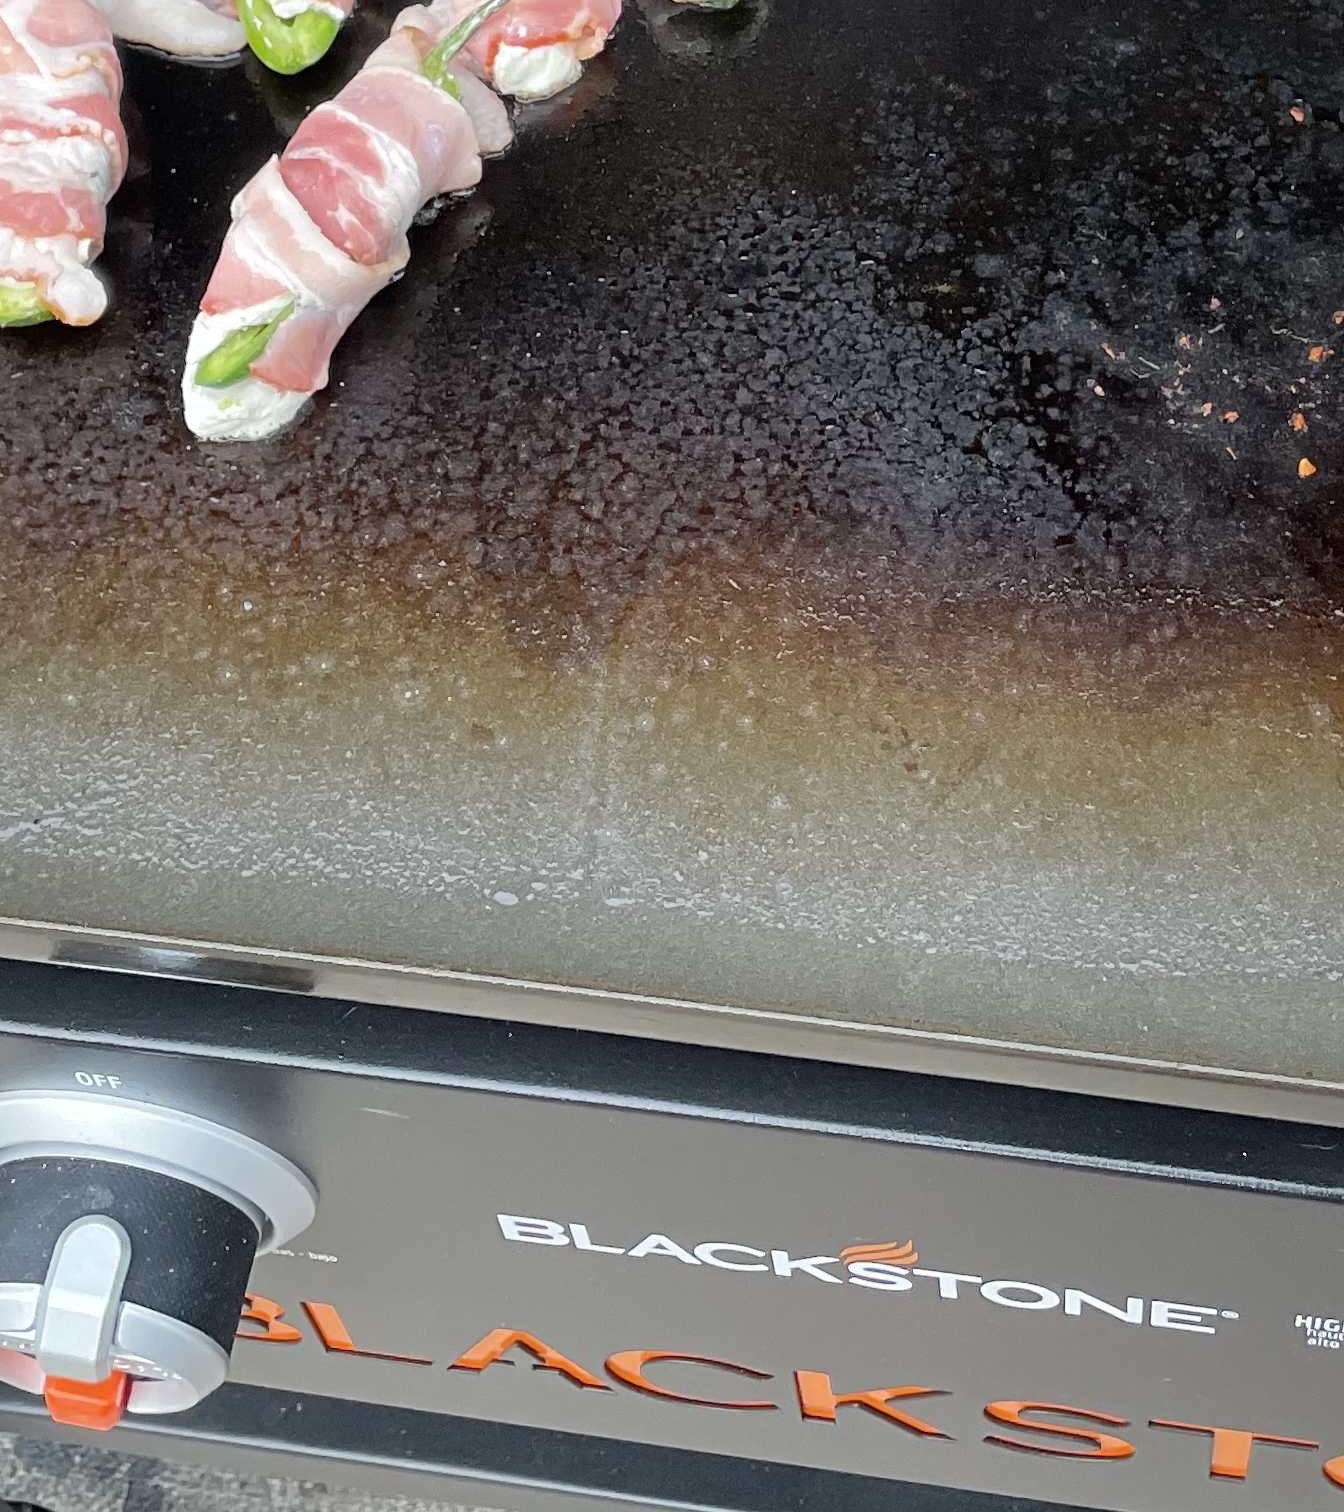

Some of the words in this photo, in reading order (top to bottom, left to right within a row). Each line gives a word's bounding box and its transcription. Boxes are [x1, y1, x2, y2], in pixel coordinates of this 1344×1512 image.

[74, 1071, 123, 1089] OFF
[497, 1214, 1218, 1334] BLACKSTONE
[1306, 1328, 1344, 1341] haut
[1307, 1338, 1341, 1349] alto
